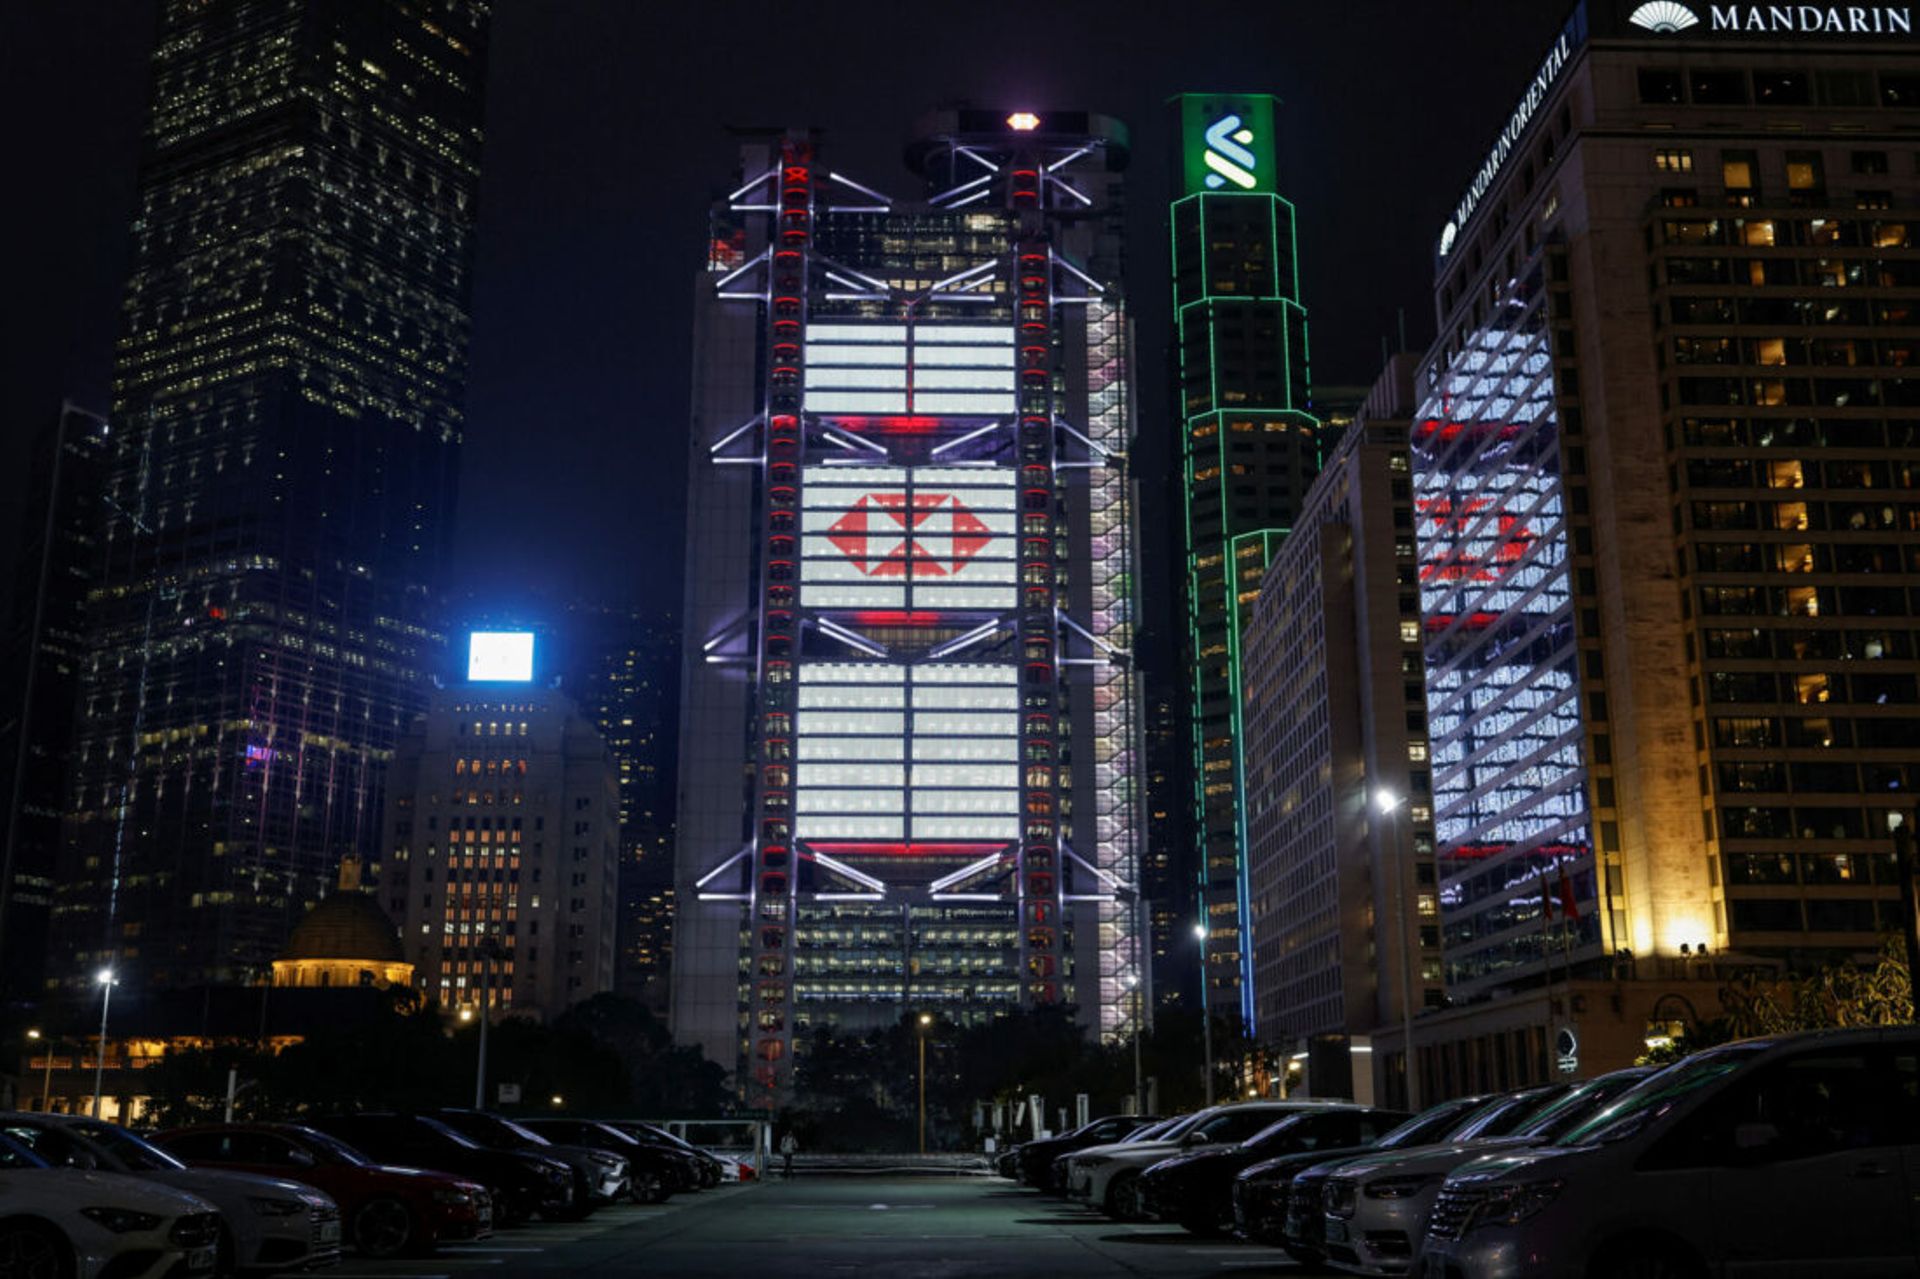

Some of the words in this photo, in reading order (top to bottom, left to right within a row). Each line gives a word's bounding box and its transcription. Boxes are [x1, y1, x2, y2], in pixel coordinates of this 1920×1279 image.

[1710, 5, 1911, 33] MANDARIN
[1457, 127, 1511, 229] MANDARIN
[1510, 34, 1570, 140] ORIENTAL
